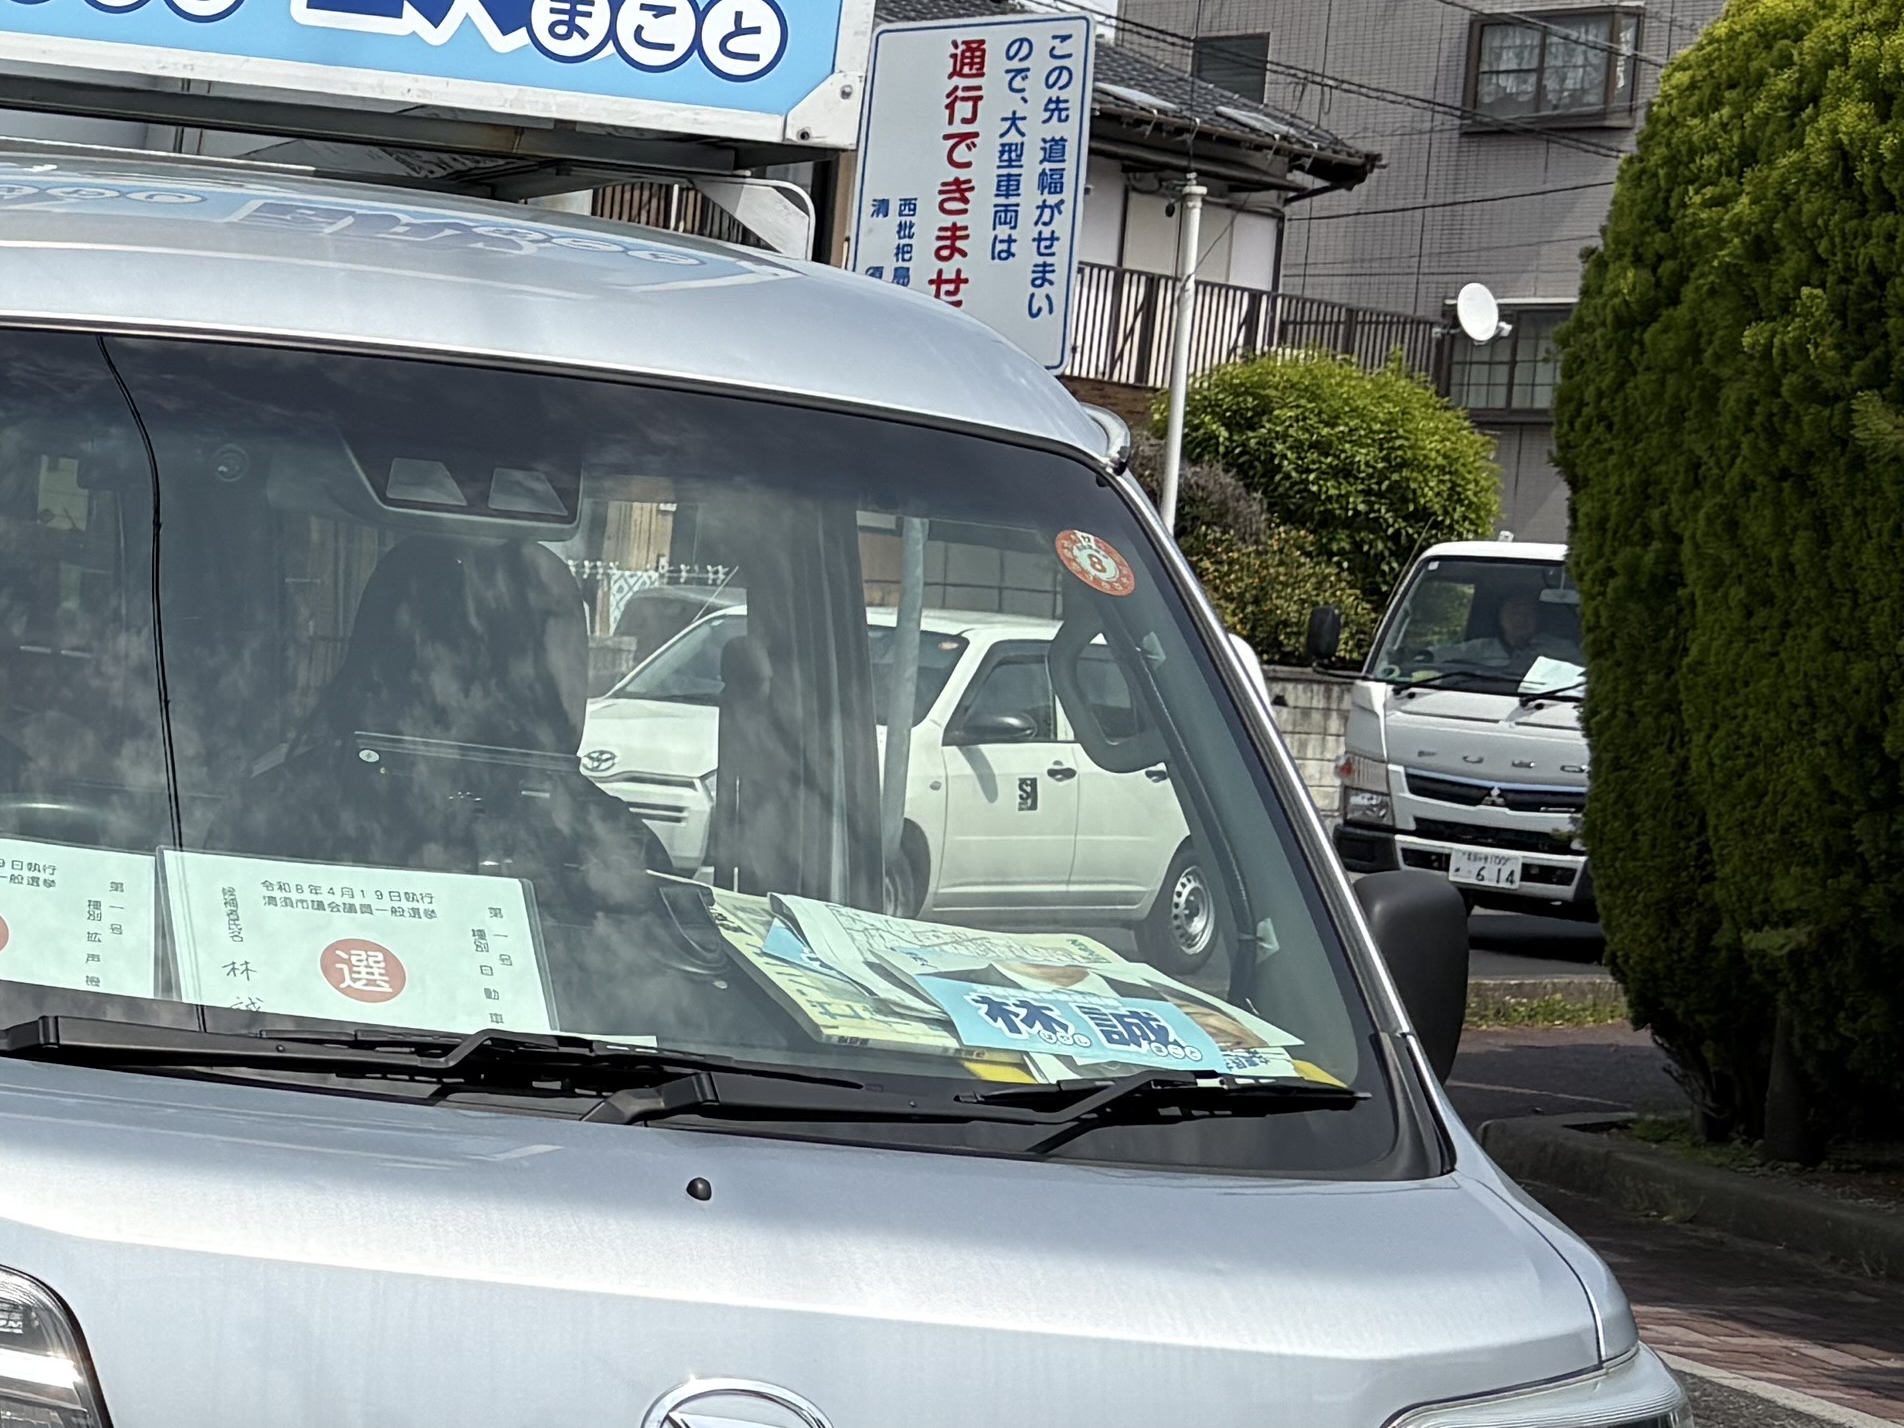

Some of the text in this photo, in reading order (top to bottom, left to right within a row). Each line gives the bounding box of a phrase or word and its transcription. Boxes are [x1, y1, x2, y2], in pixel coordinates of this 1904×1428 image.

[990, 35, 1034, 262] ので、大型車両は
[1027, 33, 1074, 320] この先 道幅がせまい
[1086, 553, 1108, 574] 8
[221, 960, 258, 982] 林
[334, 948, 393, 994] 選
[969, 995, 1074, 1035] 林
